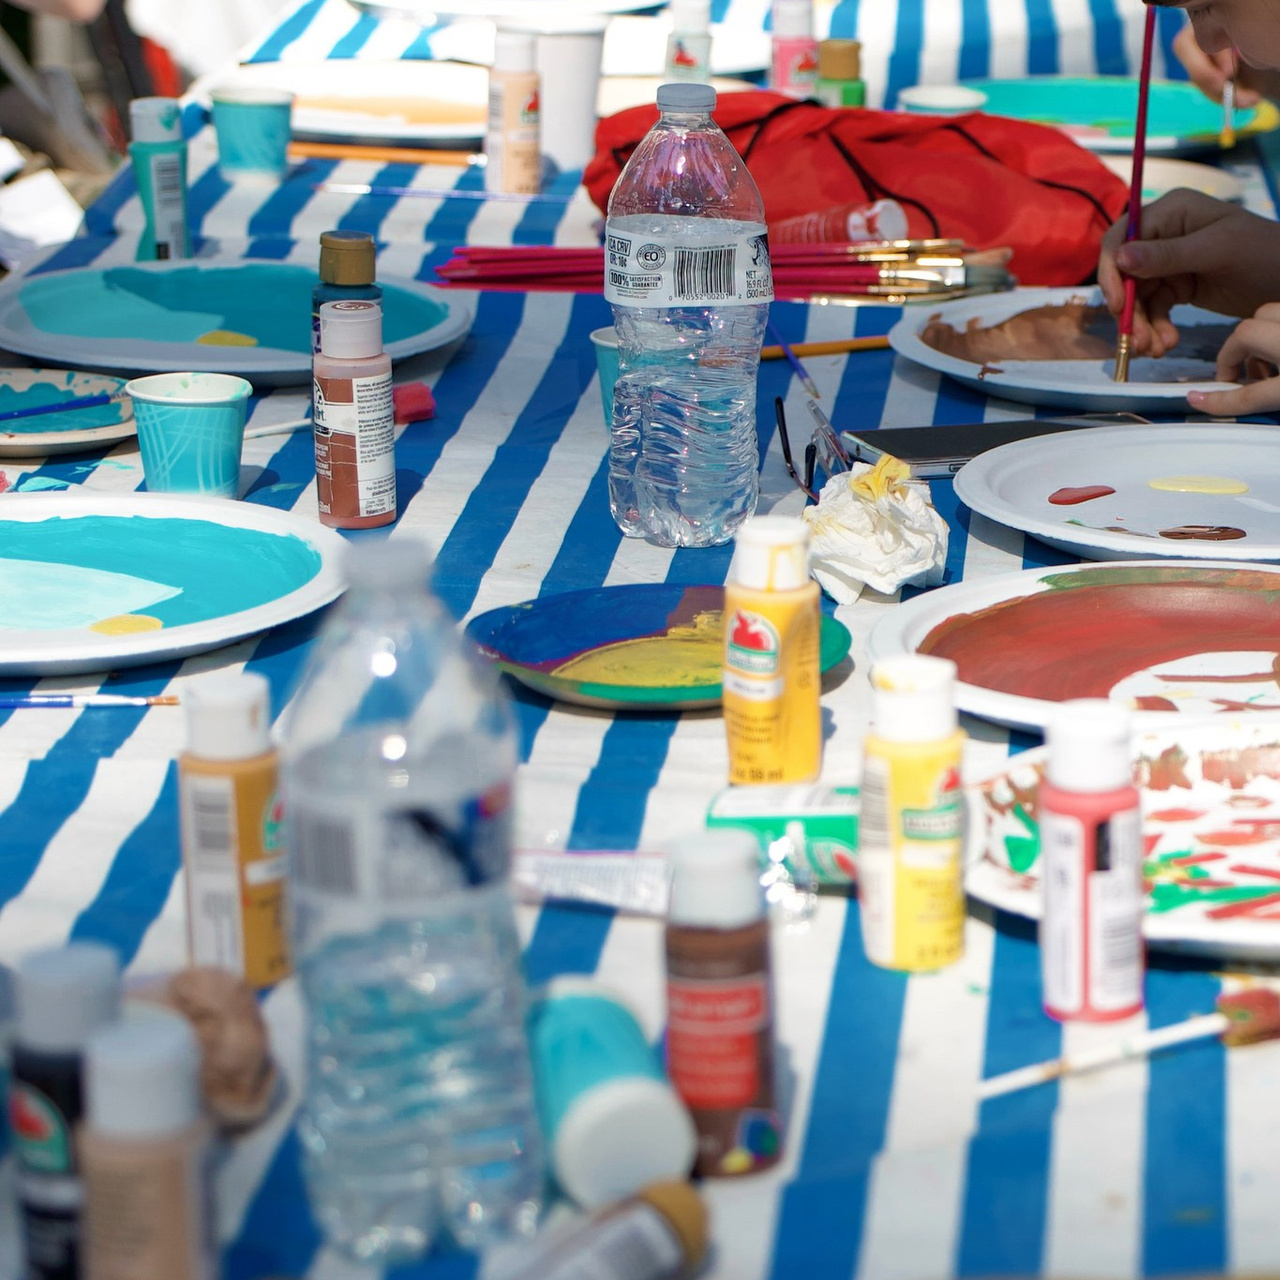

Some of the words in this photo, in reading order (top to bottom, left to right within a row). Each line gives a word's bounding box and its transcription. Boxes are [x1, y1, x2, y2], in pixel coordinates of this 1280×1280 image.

[617, 240, 630, 253] CRV
[644, 251, 658, 261] EO
[611, 272, 629, 287] 100%
[746, 271, 756, 279] NET
[747, 289, 758, 298] (500
